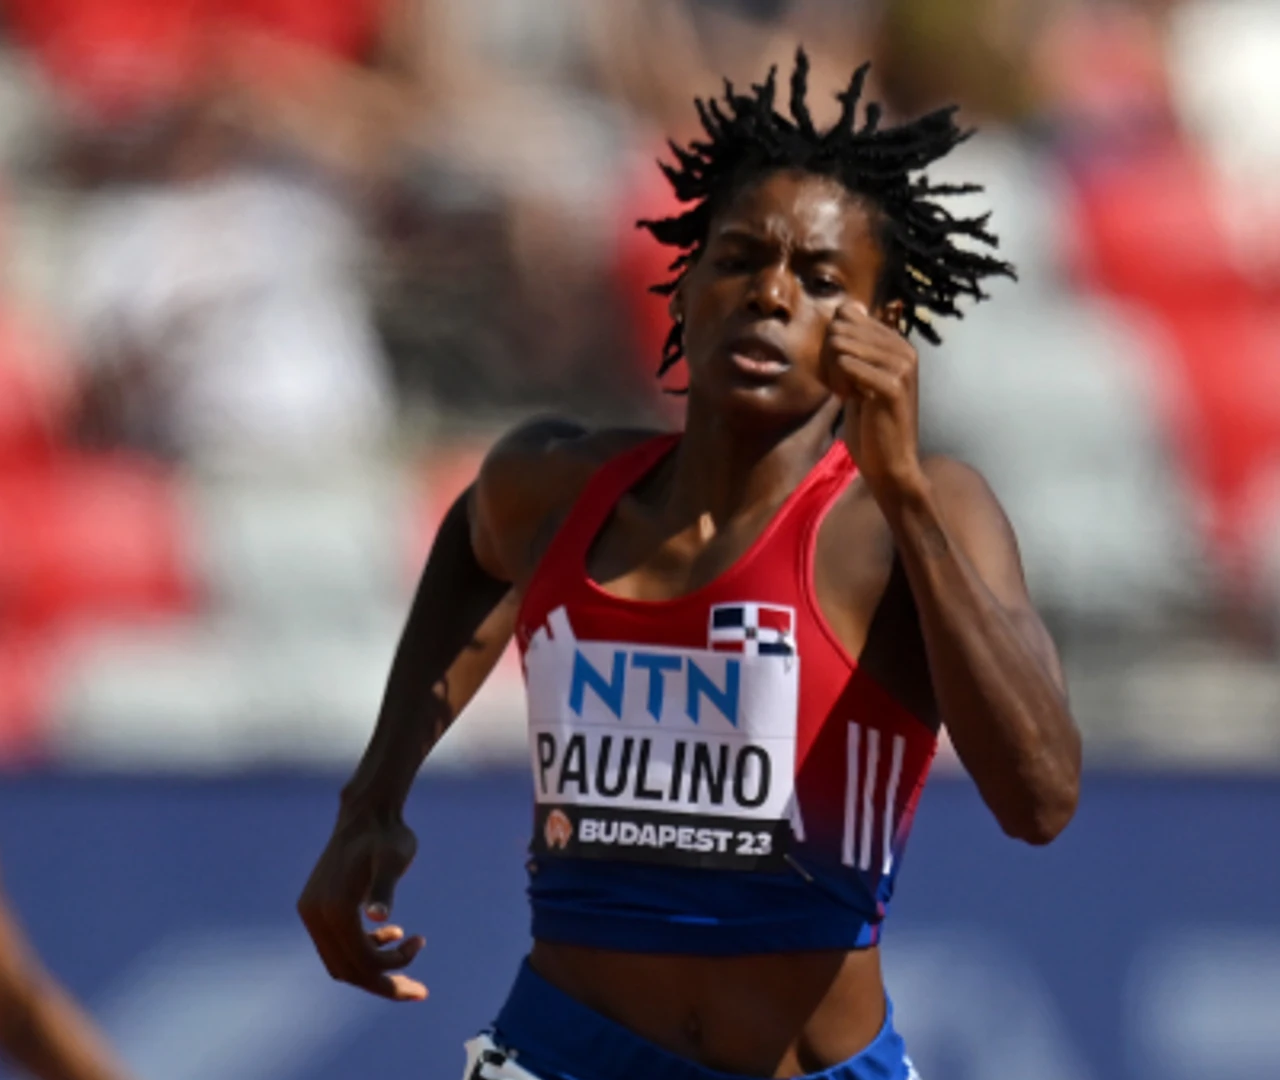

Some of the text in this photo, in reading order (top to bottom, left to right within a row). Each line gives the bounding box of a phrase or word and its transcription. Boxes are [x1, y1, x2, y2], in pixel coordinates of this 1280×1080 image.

[568, 650, 741, 728] NTN
[536, 731, 772, 809] PAULINO
[578, 818, 772, 856] BUDAPEST 23
